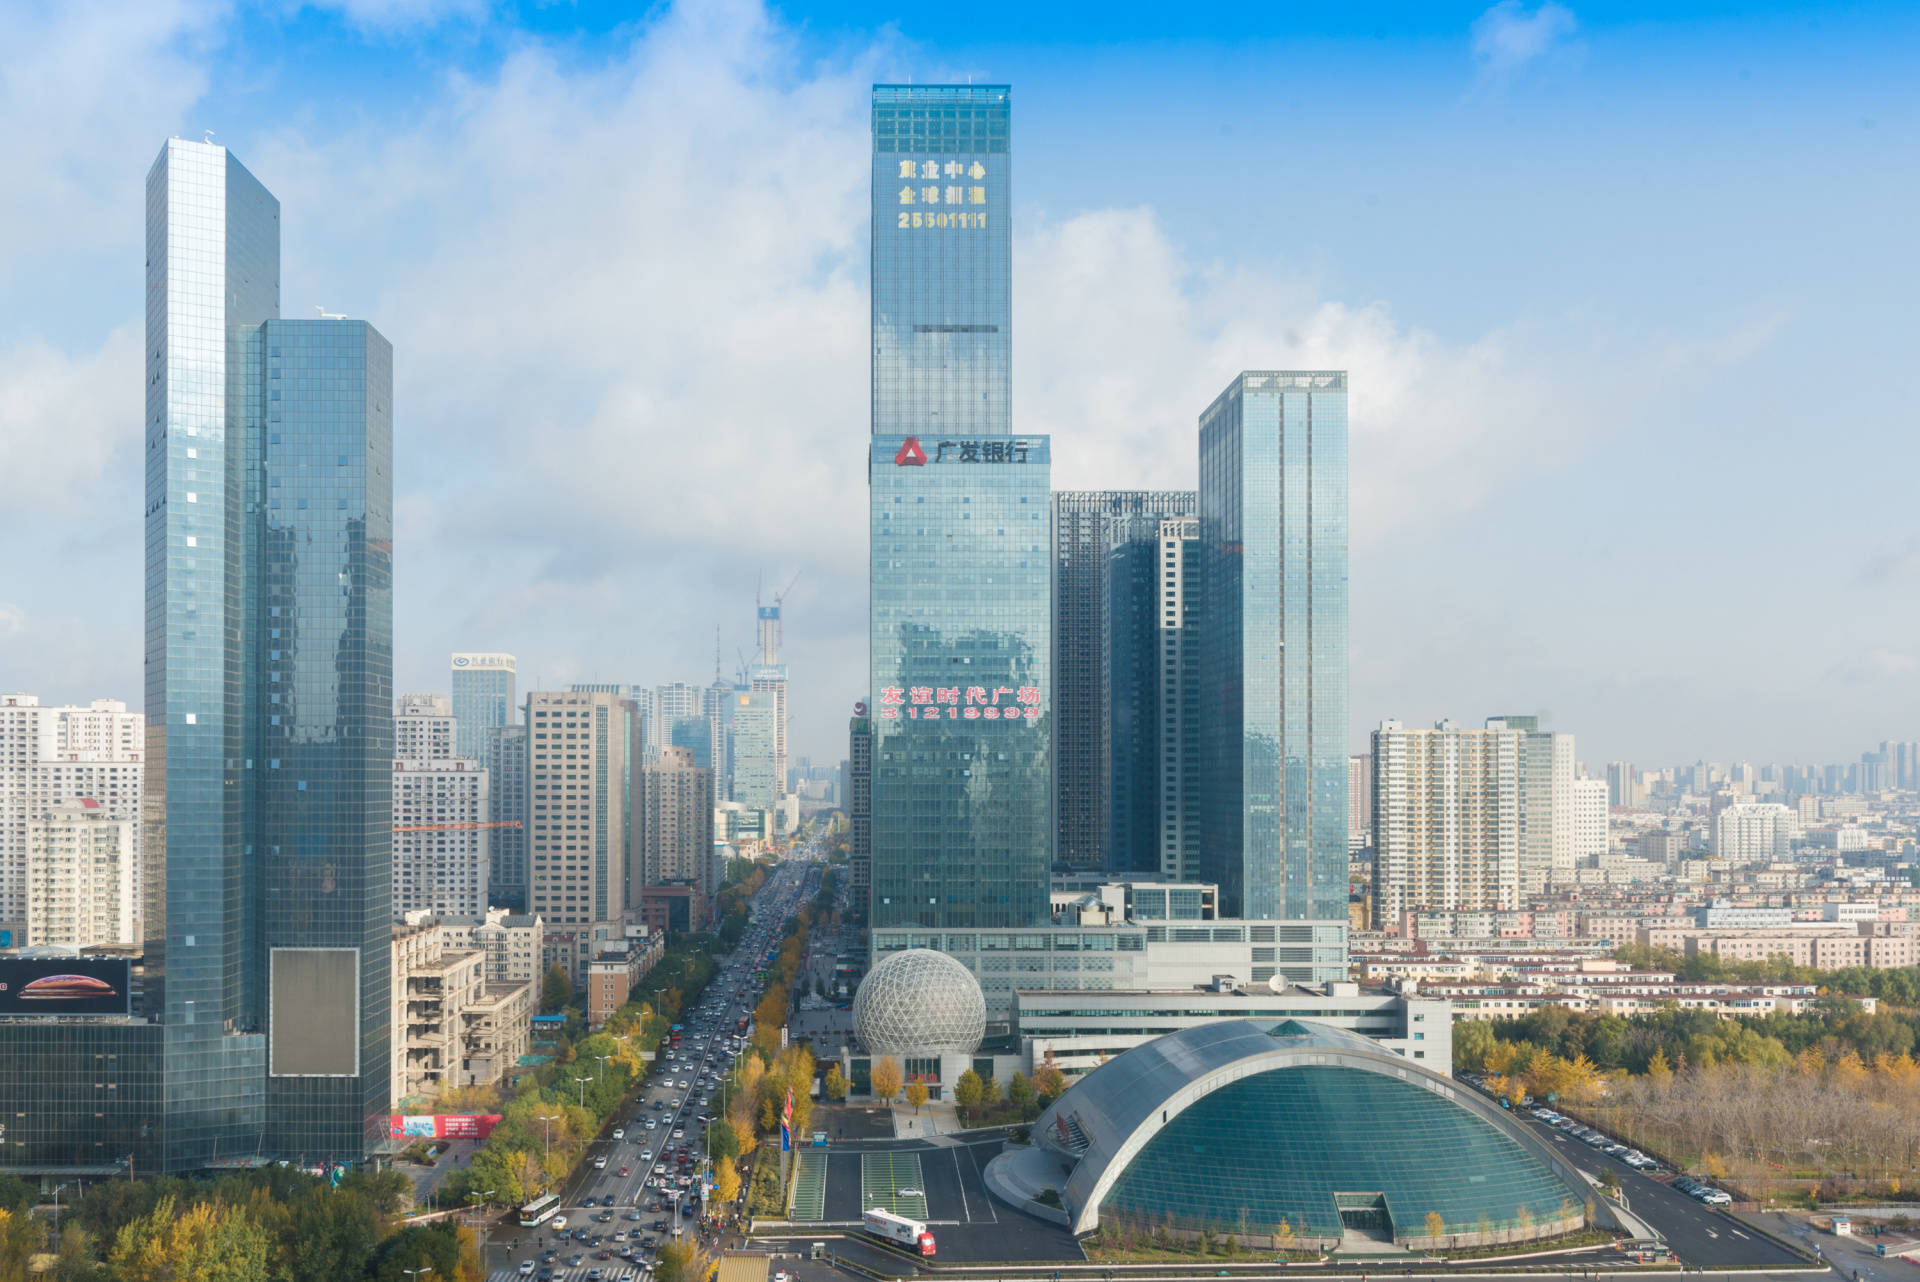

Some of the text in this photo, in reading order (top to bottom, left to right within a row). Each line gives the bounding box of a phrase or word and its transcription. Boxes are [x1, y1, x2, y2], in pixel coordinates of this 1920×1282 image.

[935, 440, 1029, 463] 广发银行
[880, 686, 1041, 705] 友谊时代广场
[881, 707, 1039, 719] 31219999
